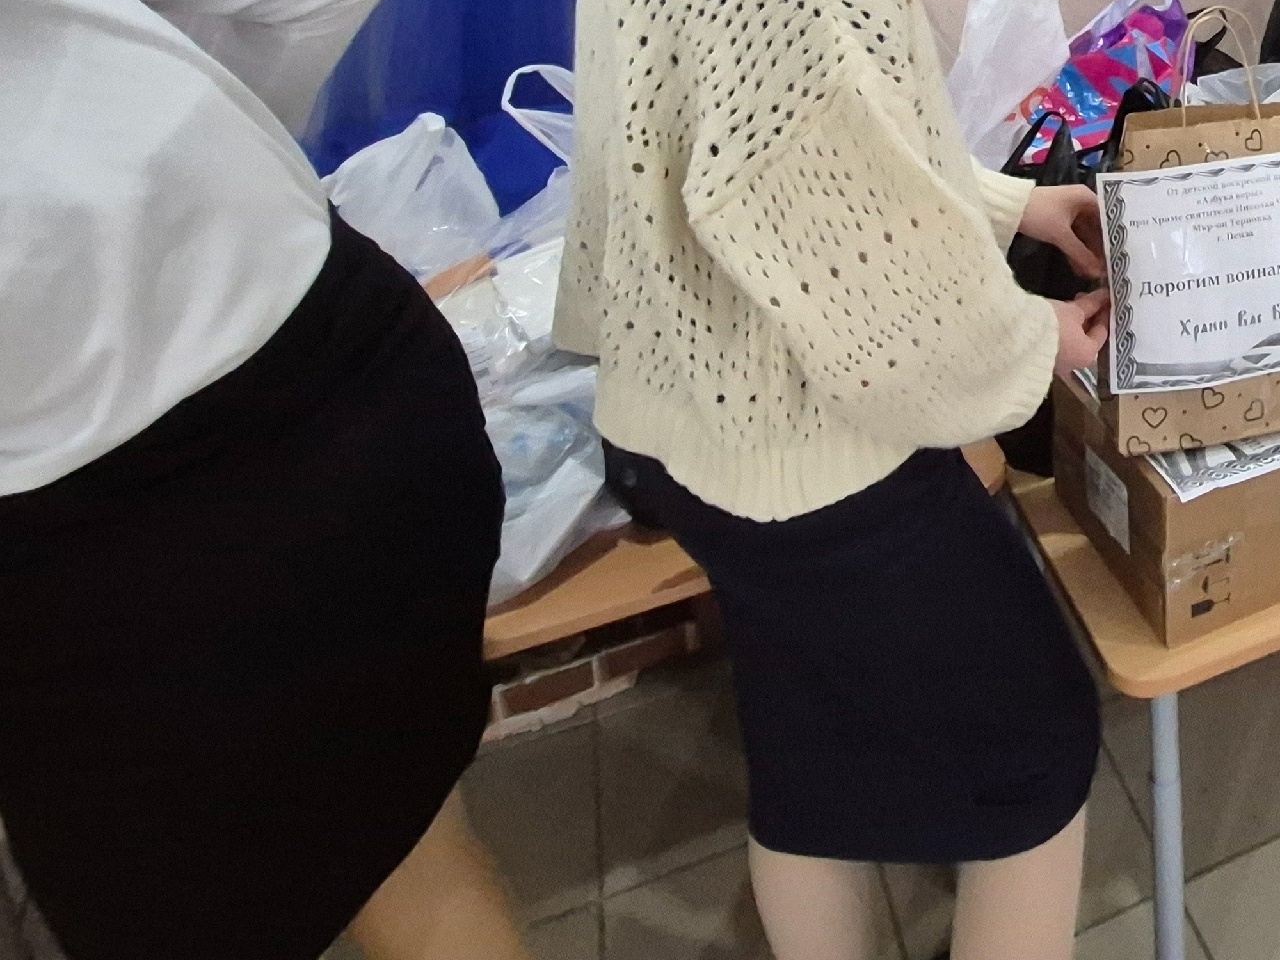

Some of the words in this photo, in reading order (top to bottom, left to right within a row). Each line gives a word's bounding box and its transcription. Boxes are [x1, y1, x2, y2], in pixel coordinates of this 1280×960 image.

[1166, 187, 1179, 197] От
[1181, 182, 1219, 197] детской
[1129, 218, 1149, 229] при
[1151, 214, 1183, 227] Храме
[1185, 207, 1234, 221] святителя
[1226, 230, 1255, 241] Пенза
[1139, 275, 1220, 298] Дорогим
[1180, 318, 1228, 342] Храни
[1237, 309, 1262, 327] Вас
